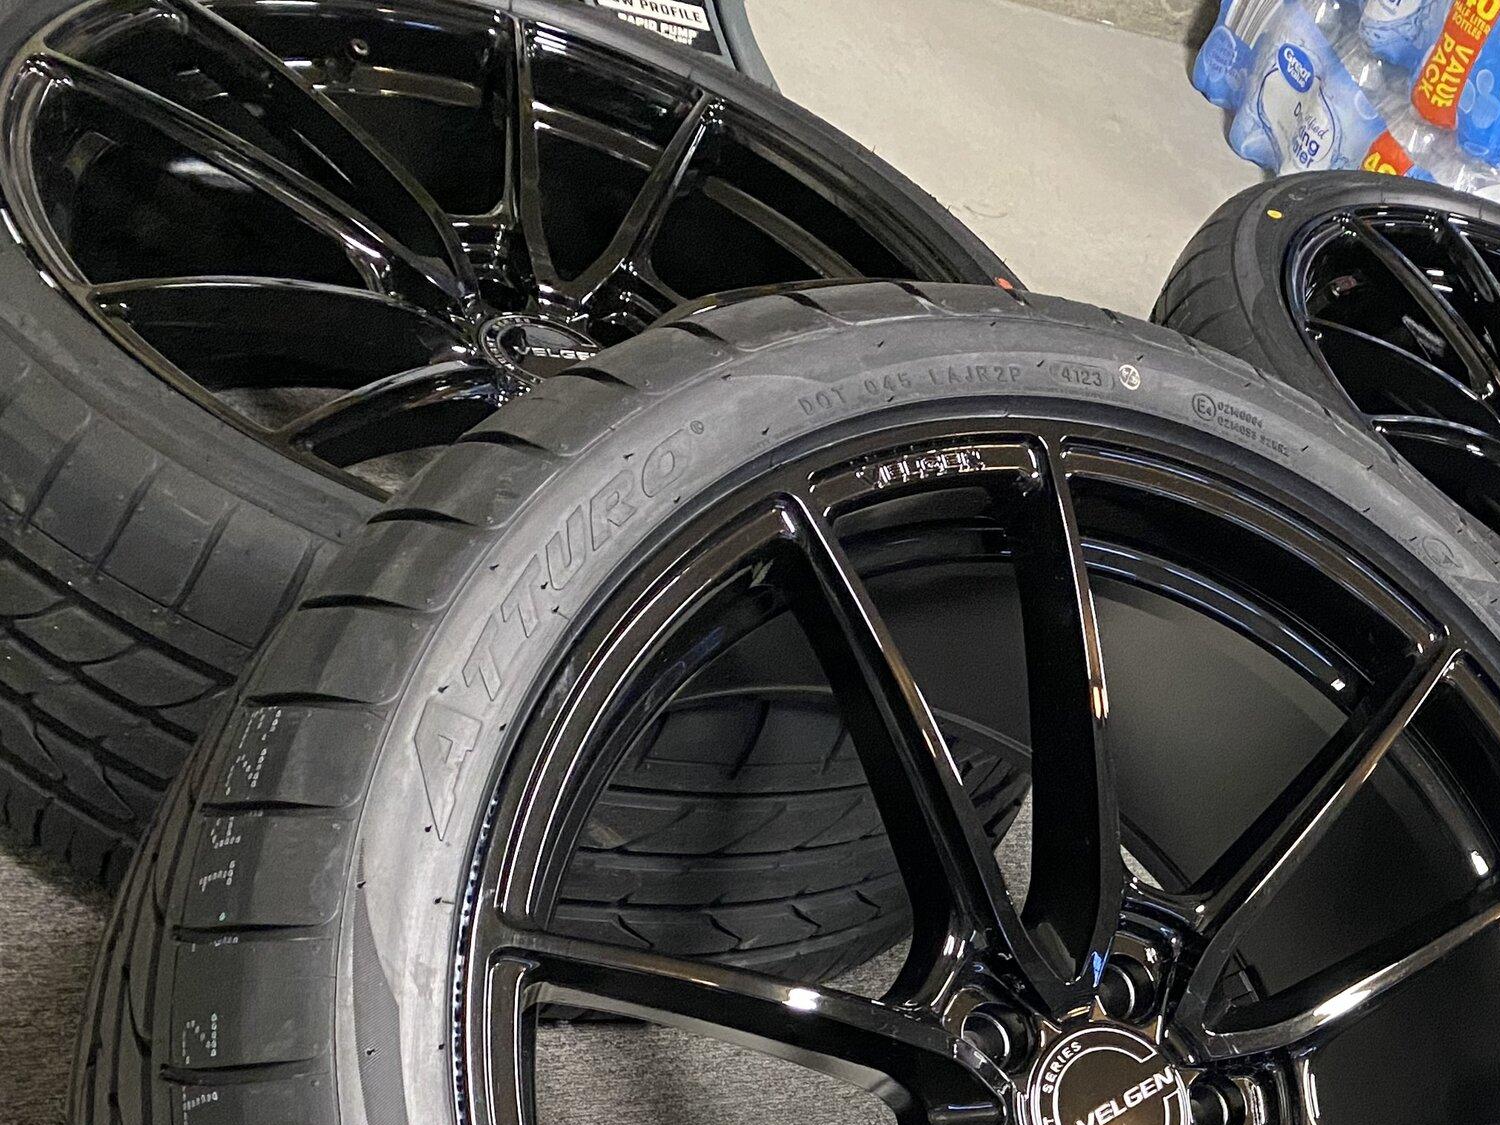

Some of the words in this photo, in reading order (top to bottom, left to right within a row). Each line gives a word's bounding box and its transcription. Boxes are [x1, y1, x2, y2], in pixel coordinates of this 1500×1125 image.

[640, 1, 703, 23] PROFILE
[1284, 47, 1311, 82] Great
[1419, 32, 1456, 99] PACK
[1431, 45, 1475, 108] VALUE
[513, 345, 597, 361] VELGE
[798, 386, 851, 416] DOT
[1060, 367, 1104, 388] 4123
[1042, 1041, 1082, 1094] SERIES
